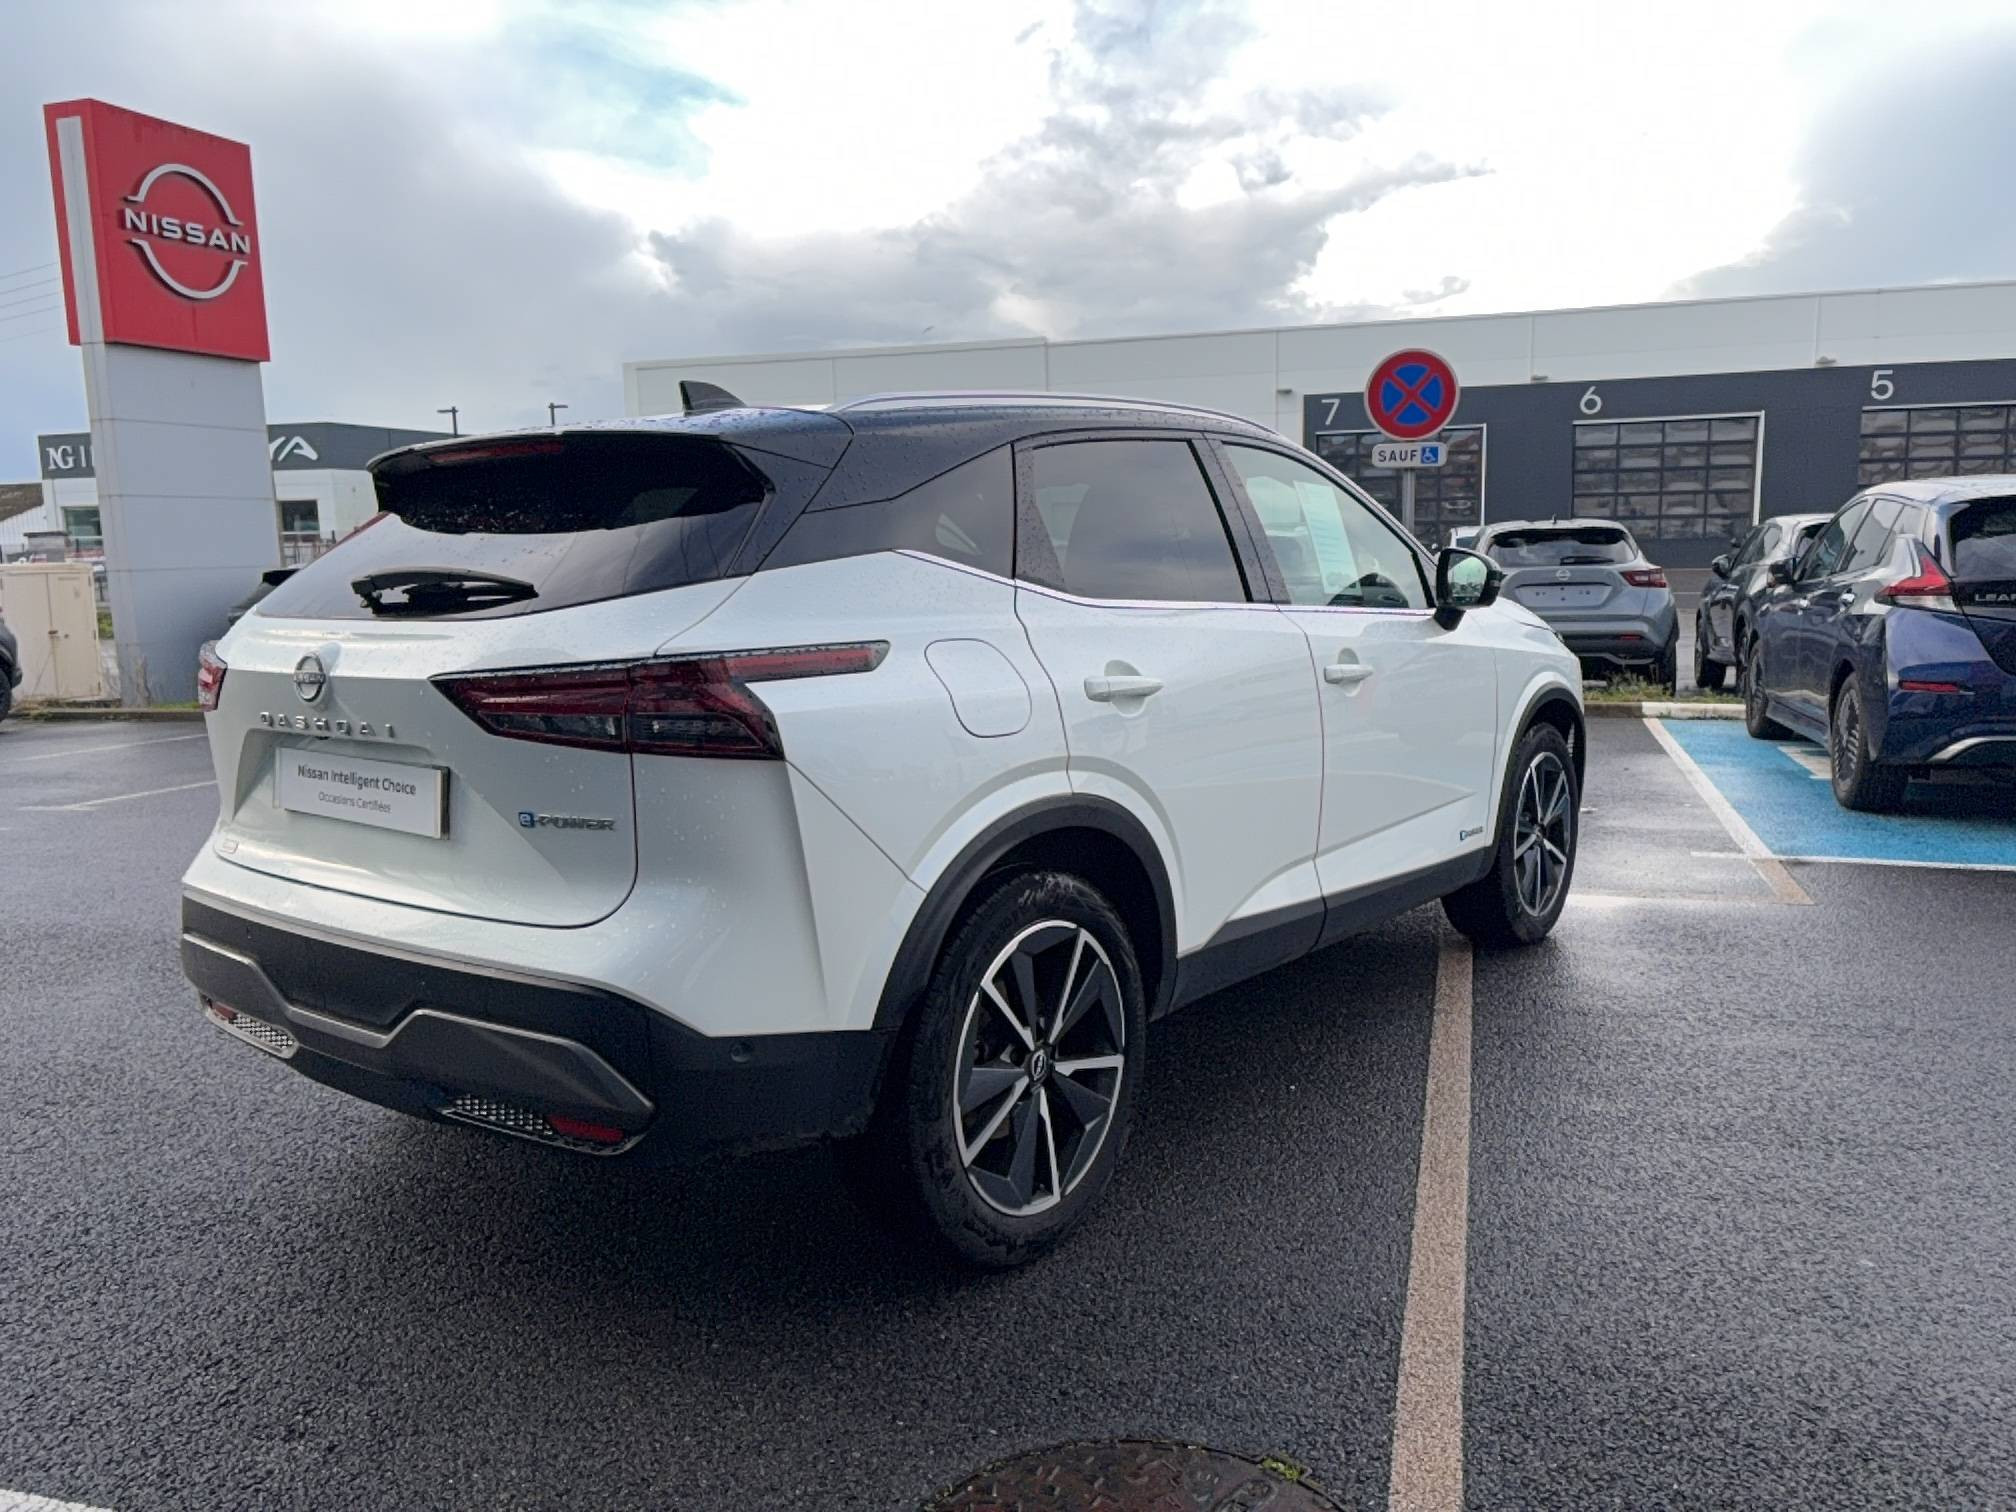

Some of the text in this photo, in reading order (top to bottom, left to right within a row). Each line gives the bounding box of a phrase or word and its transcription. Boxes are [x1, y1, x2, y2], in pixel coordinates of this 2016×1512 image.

[124, 208, 251, 255] NISSAN
[1870, 369, 1894, 400] 5
[1321, 398, 1341, 426] 7
[1579, 385, 1602, 415] 6
[1377, 449, 1418, 463] SAUF
[298, 765, 417, 797] Nissan Intelligent Choice
[318, 791, 355, 807] Occasions
